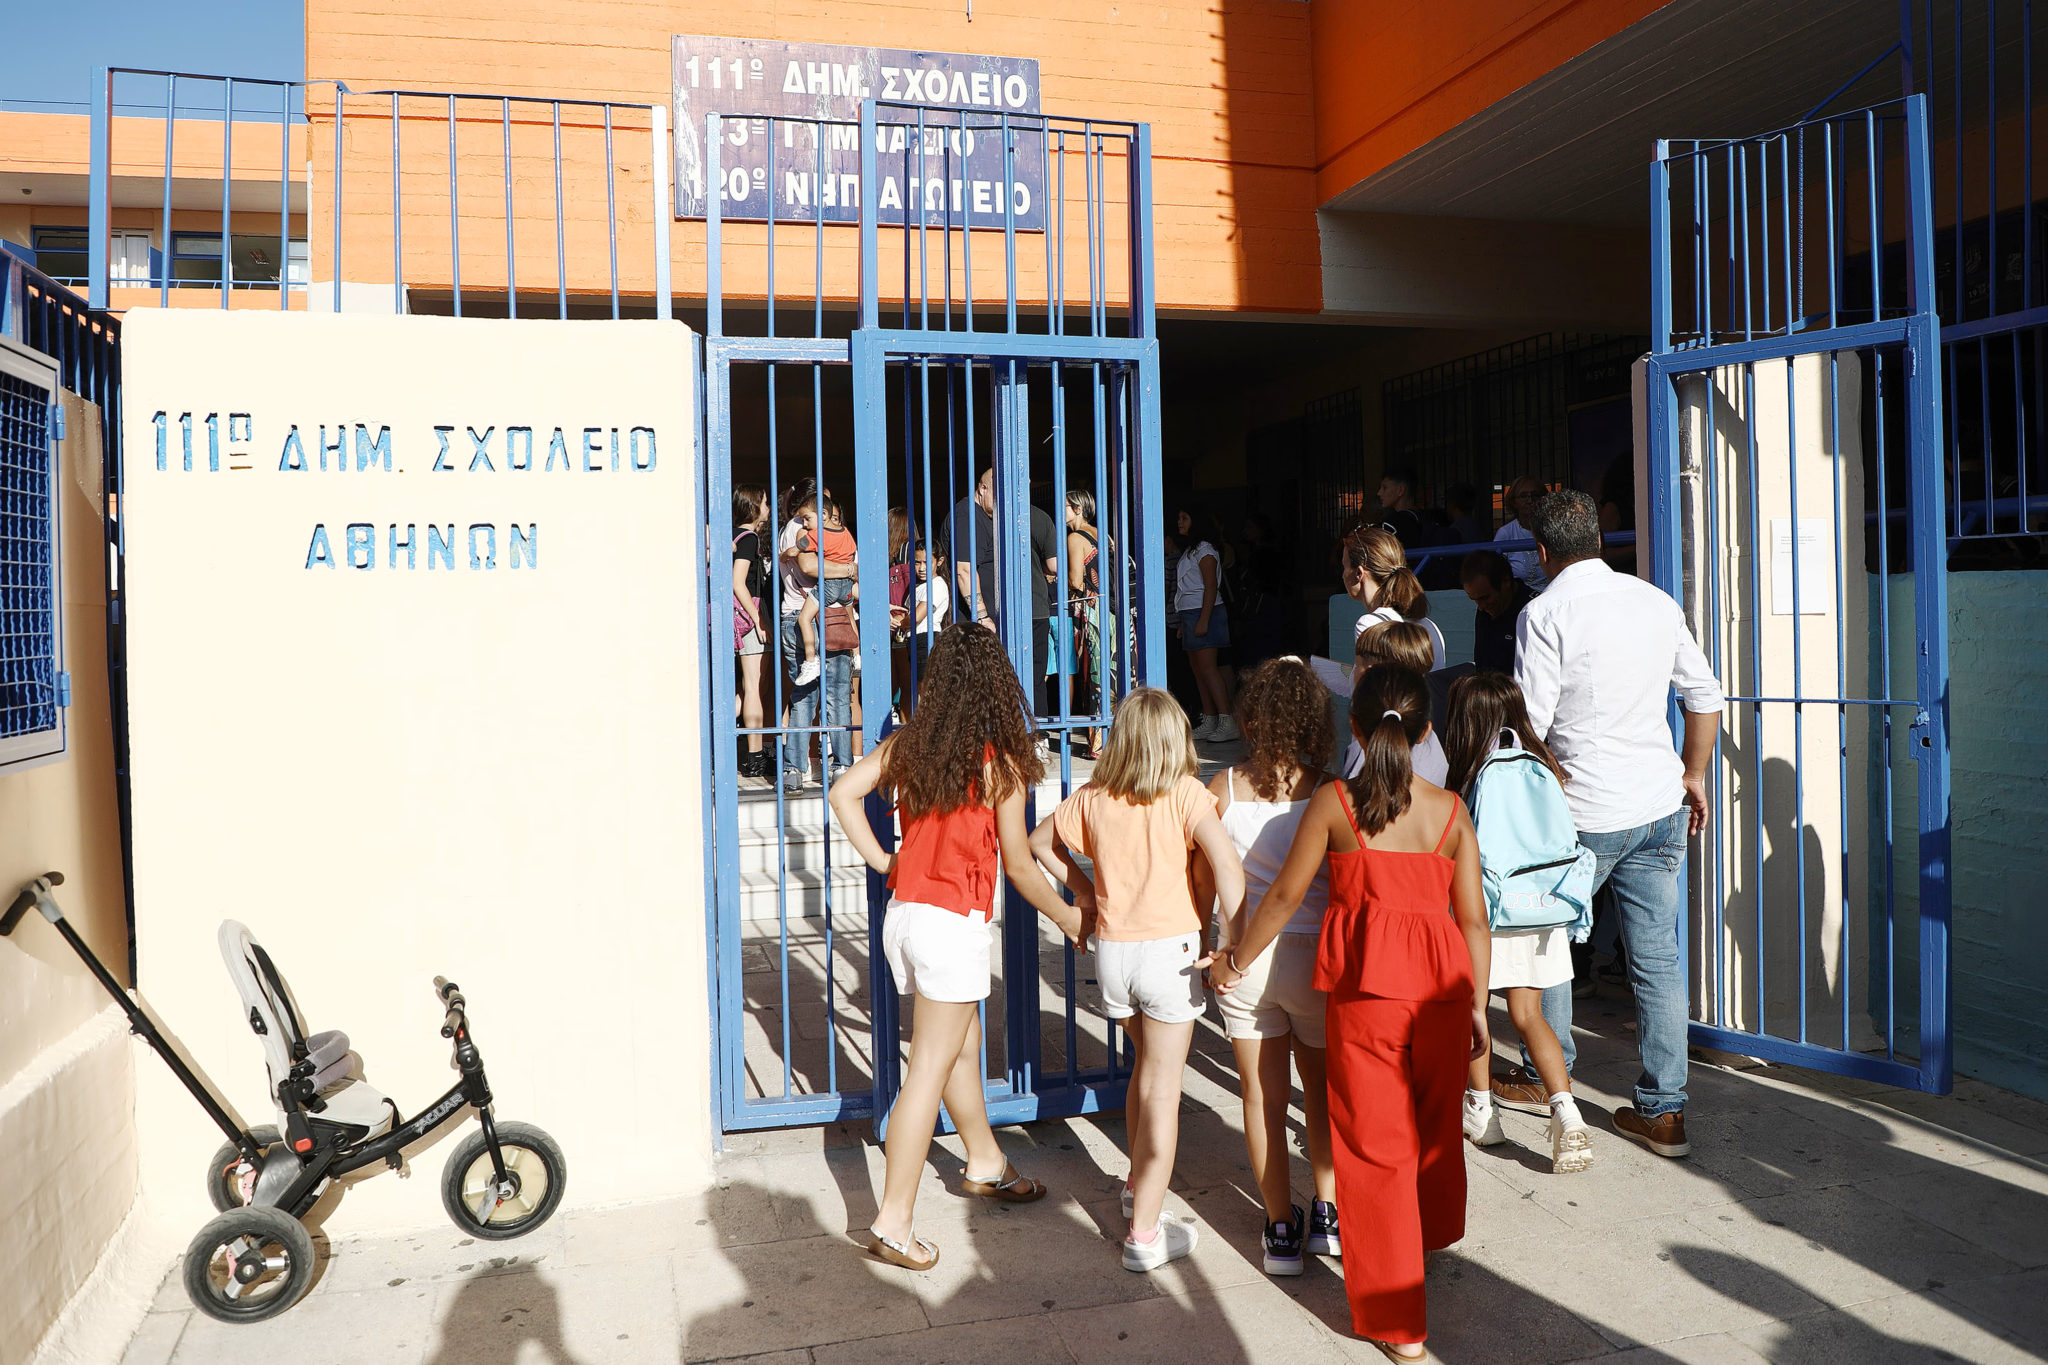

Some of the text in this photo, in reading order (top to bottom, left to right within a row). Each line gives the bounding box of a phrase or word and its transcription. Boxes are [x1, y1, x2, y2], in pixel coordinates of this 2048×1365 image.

[782, 60, 870, 97] ΔΗΜ.
[880, 66, 1028, 108] ΣΧΟΛΕΙΟ
[785, 171, 1031, 216] ΝΗΠΑΓΩΓΕΙΟ
[279, 424, 404, 472] ΔΗΜ.
[432, 425, 657, 472] ΣΧΟΛΕΙΟ
[305, 523, 537, 570] ΑΘΗΝΩΝ
[1505, 891, 1557, 910] POLO
[1273, 1238, 1290, 1247] FILA
